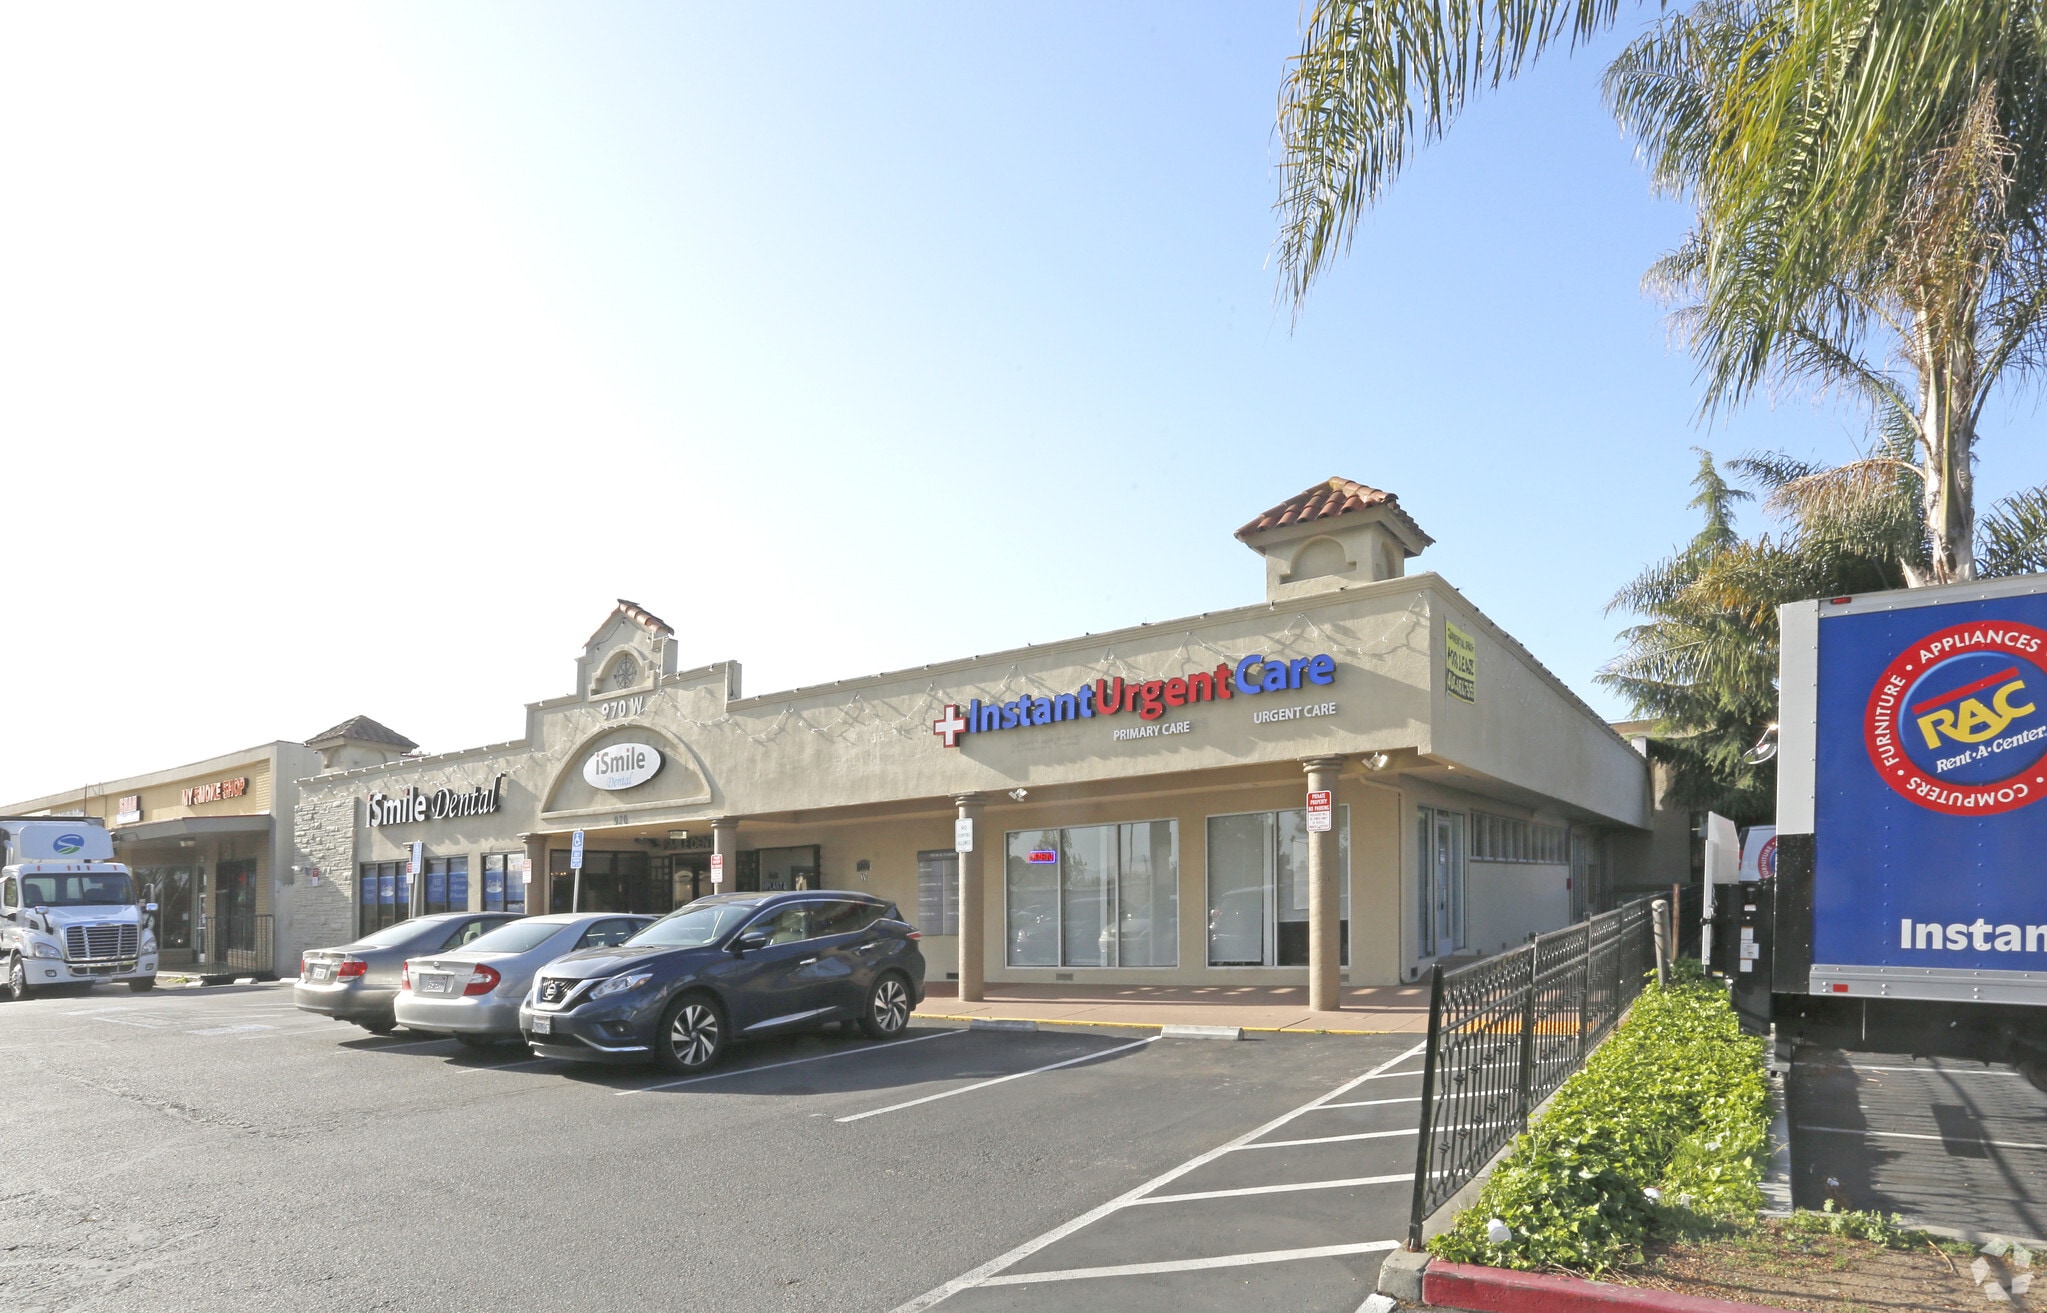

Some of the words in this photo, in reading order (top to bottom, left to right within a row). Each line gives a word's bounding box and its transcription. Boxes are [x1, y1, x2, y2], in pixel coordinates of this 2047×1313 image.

[1919, 630, 2042, 664] APPLIANCES
[601, 700, 627, 720] 970
[631, 696, 644, 716] W
[1253, 706, 1302, 724] URGENT
[1303, 702, 1337, 718] CARE
[1874, 674, 1906, 767] FURNITURE
[1917, 680, 2036, 750] RAC
[1113, 724, 1160, 741] PRIMARY
[1162, 721, 1191, 736] CARE
[595, 746, 646, 776] iSmile
[181, 788, 194, 807] MY
[193, 783, 221, 805] SMOKE
[222, 777, 245, 799] SHOP
[607, 772, 634, 789] Dental
[1906, 777, 2029, 807] COMPUTERS
[365, 785, 428, 828] iSmile
[431, 773, 503, 819] Dental
[613, 814, 629, 826] 970
